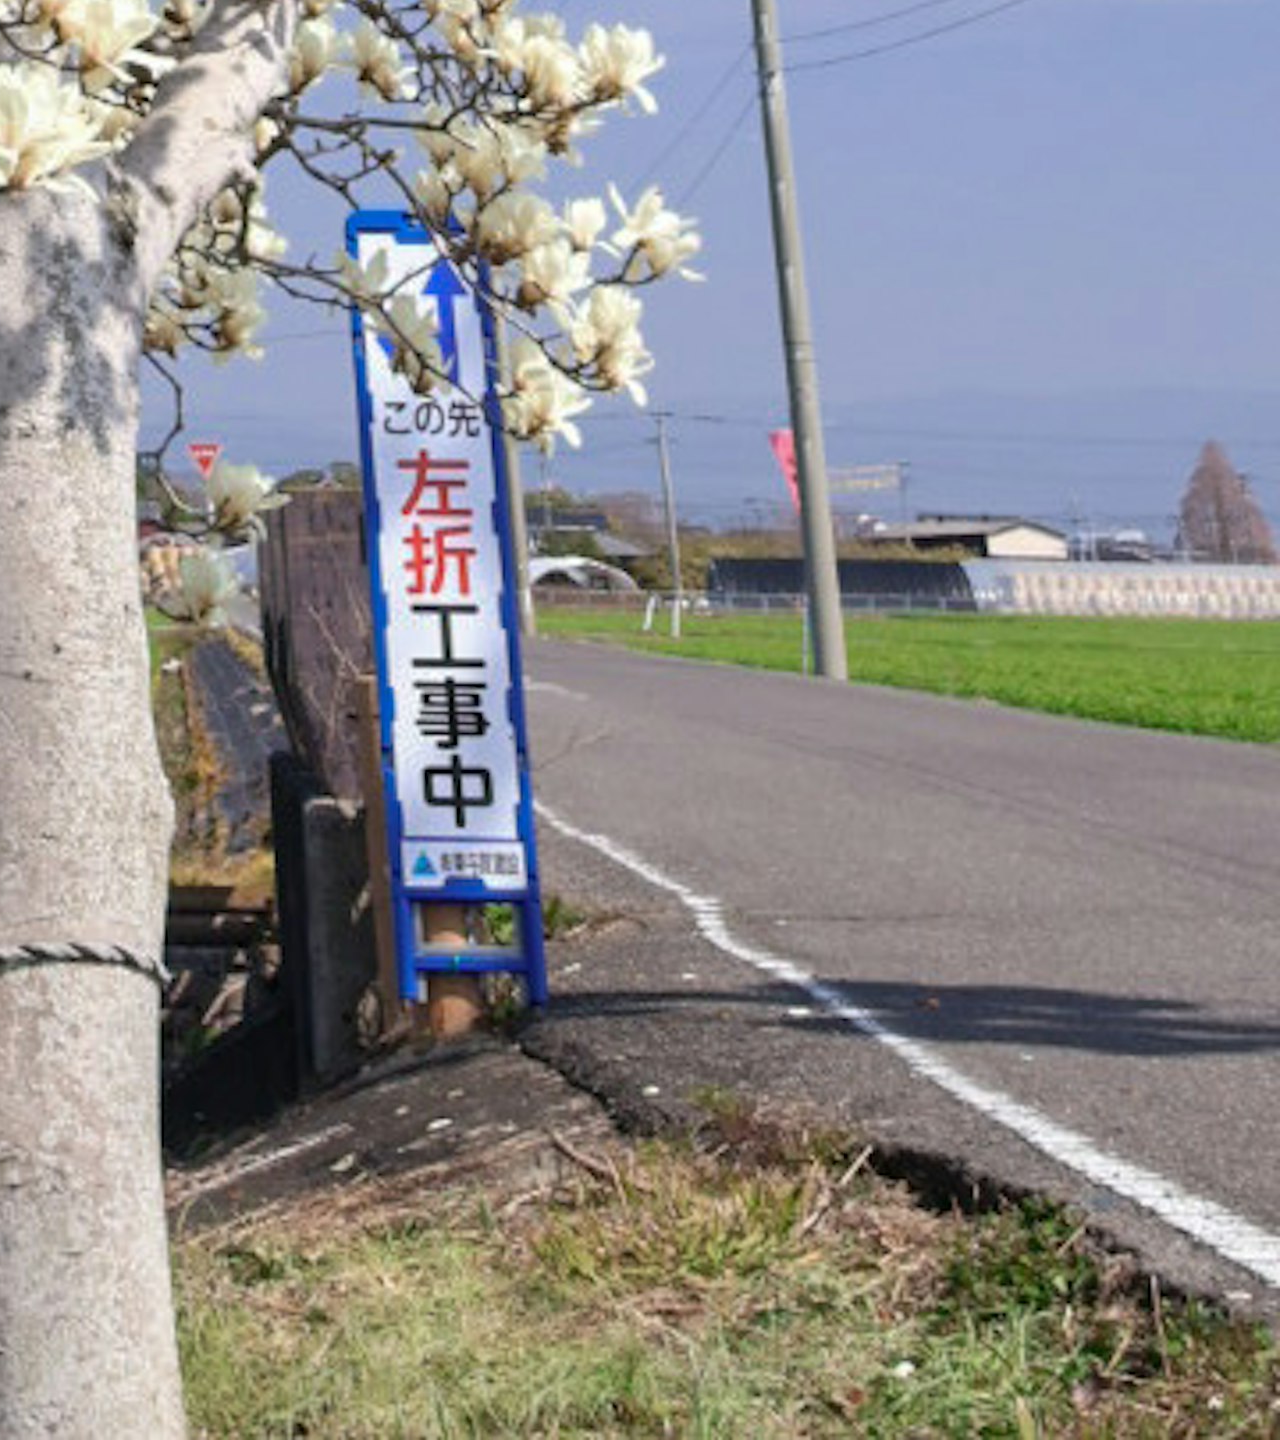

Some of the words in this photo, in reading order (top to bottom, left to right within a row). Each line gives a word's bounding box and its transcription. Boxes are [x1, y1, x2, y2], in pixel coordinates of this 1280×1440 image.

[384, 401, 481, 437] この先
[396, 449, 494, 828] 左折工事中
